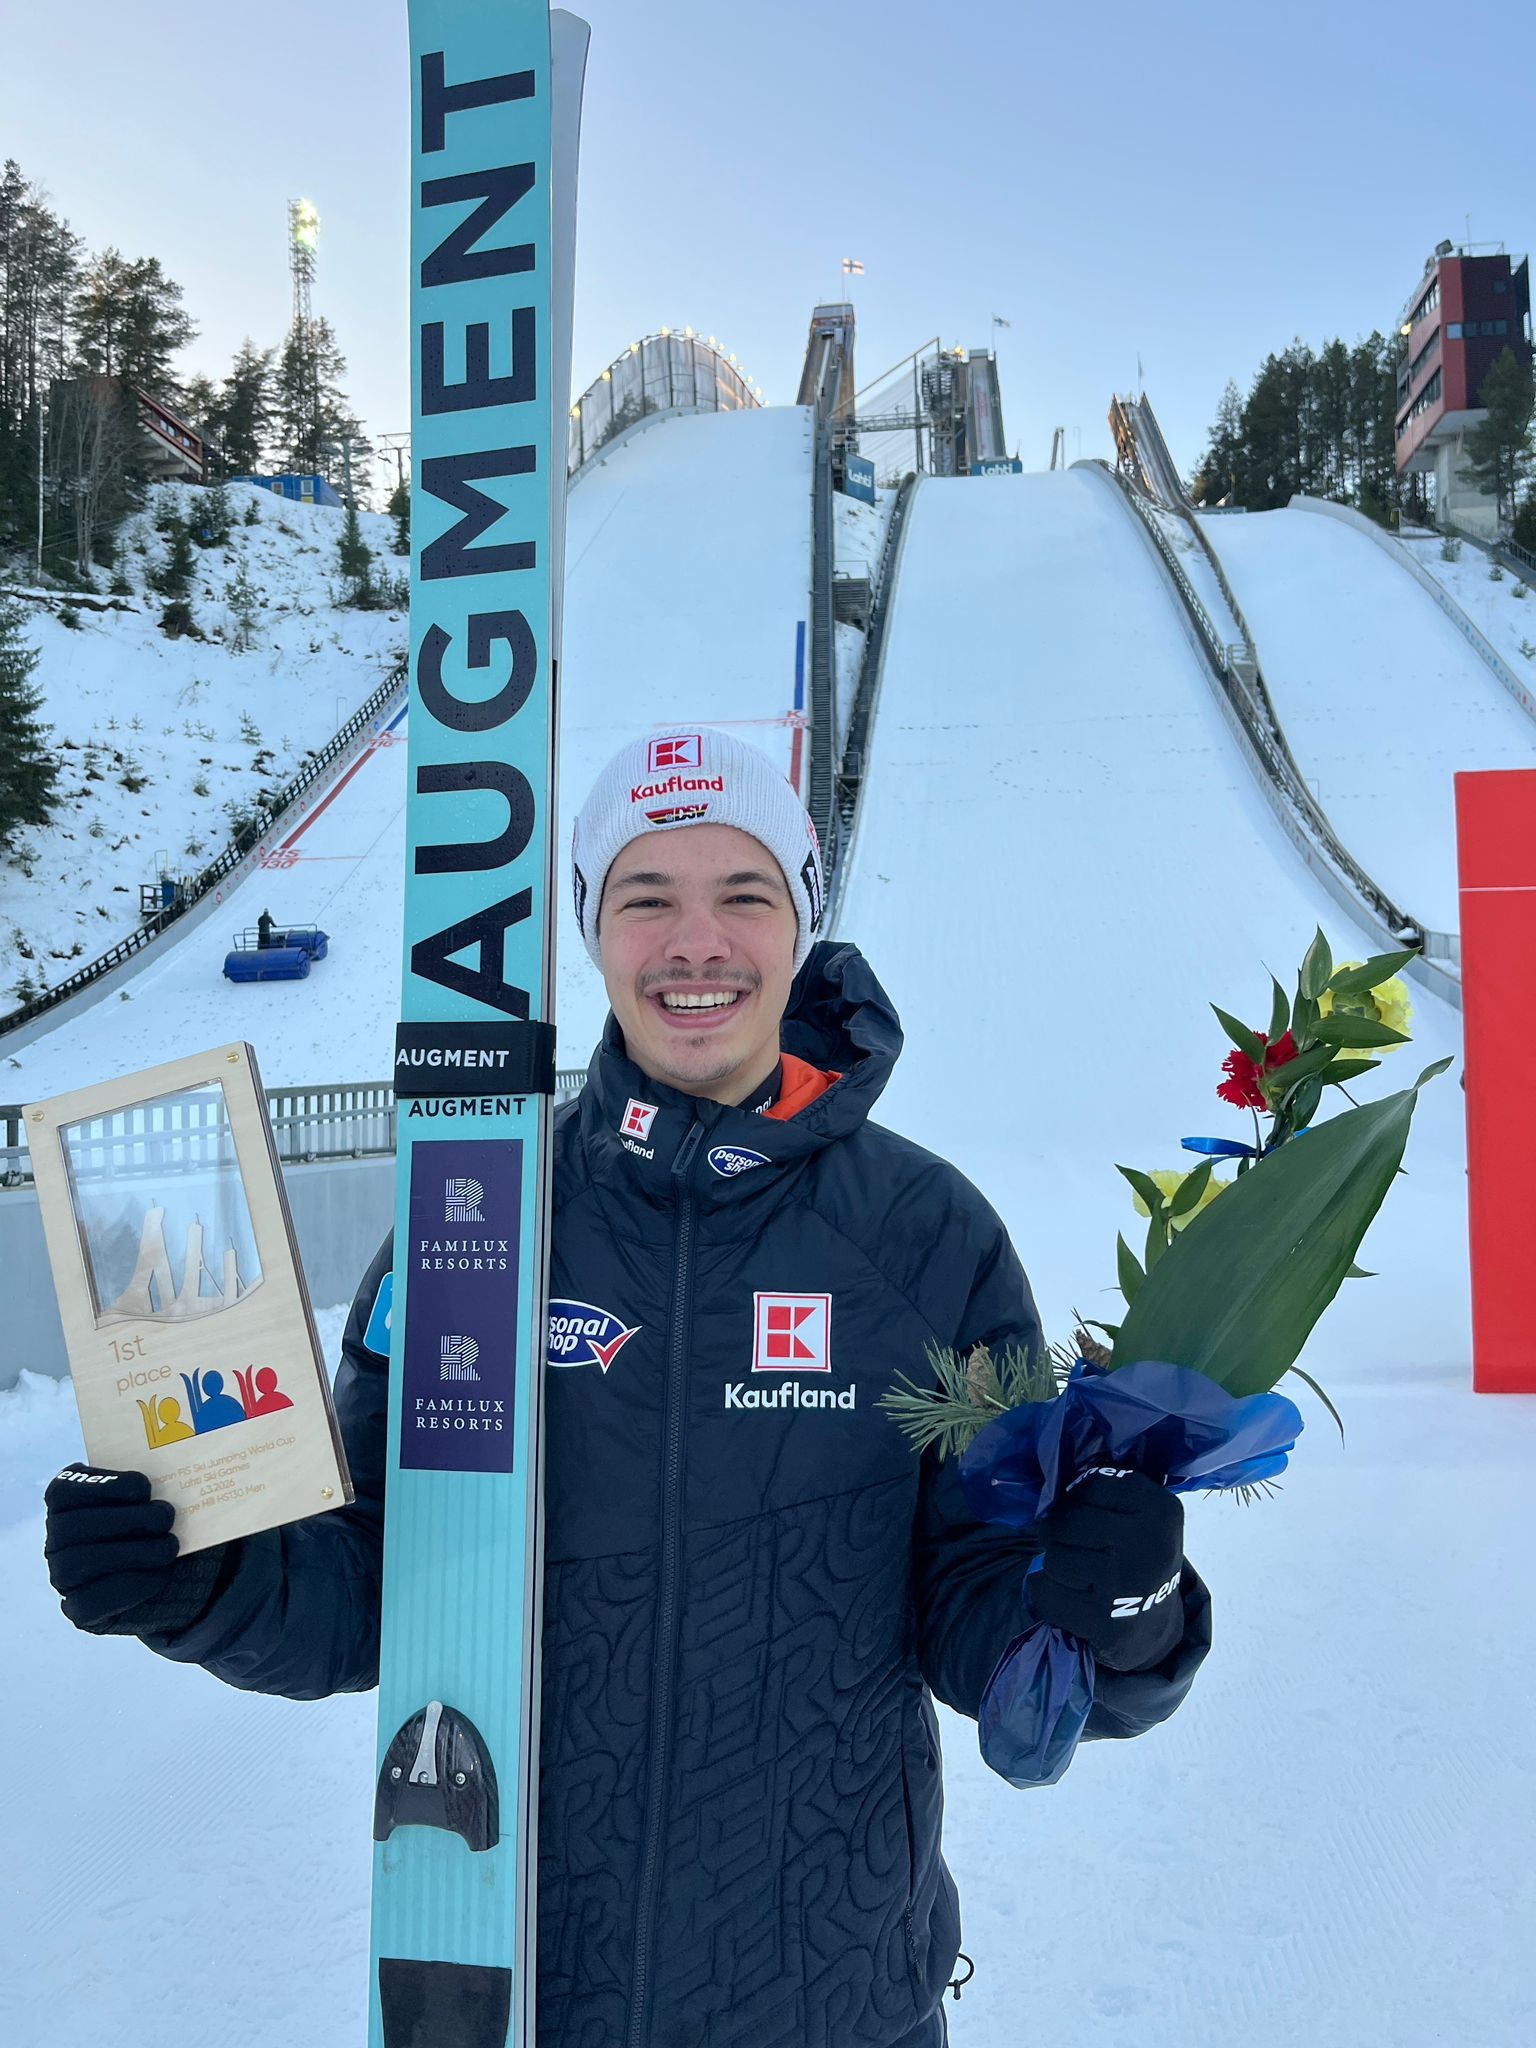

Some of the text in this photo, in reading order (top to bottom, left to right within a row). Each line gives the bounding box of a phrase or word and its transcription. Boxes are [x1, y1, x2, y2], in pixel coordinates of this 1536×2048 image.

[411, 51, 537, 1021] AUGMENT
[631, 776, 724, 803] Kaufland
[675, 803, 709, 822] DSV
[268, 850, 300, 858] HS
[261, 859, 297, 869] 130
[396, 1048, 509, 1068] AUGMENT
[408, 1097, 527, 1117] AUGMENT
[617, 1133, 655, 1160] ufland
[714, 1150, 764, 1168] person
[420, 1240, 509, 1252] FAMILUX
[421, 1258, 507, 1270] RESORTS
[549, 1316, 610, 1336] sonal
[108, 1335, 147, 1363] 1st
[117, 1365, 171, 1397] place
[415, 1398, 504, 1413] FAMILUX
[724, 1382, 856, 1410] Kaufland
[416, 1416, 503, 1431] RESORTS
[207, 1449, 247, 1469] Jumping
[247, 1441, 275, 1456] World
[275, 1435, 297, 1449] Cup
[57, 1470, 119, 1484] ener
[217, 1462, 251, 1478] Games
[245, 1481, 266, 1495] Men
